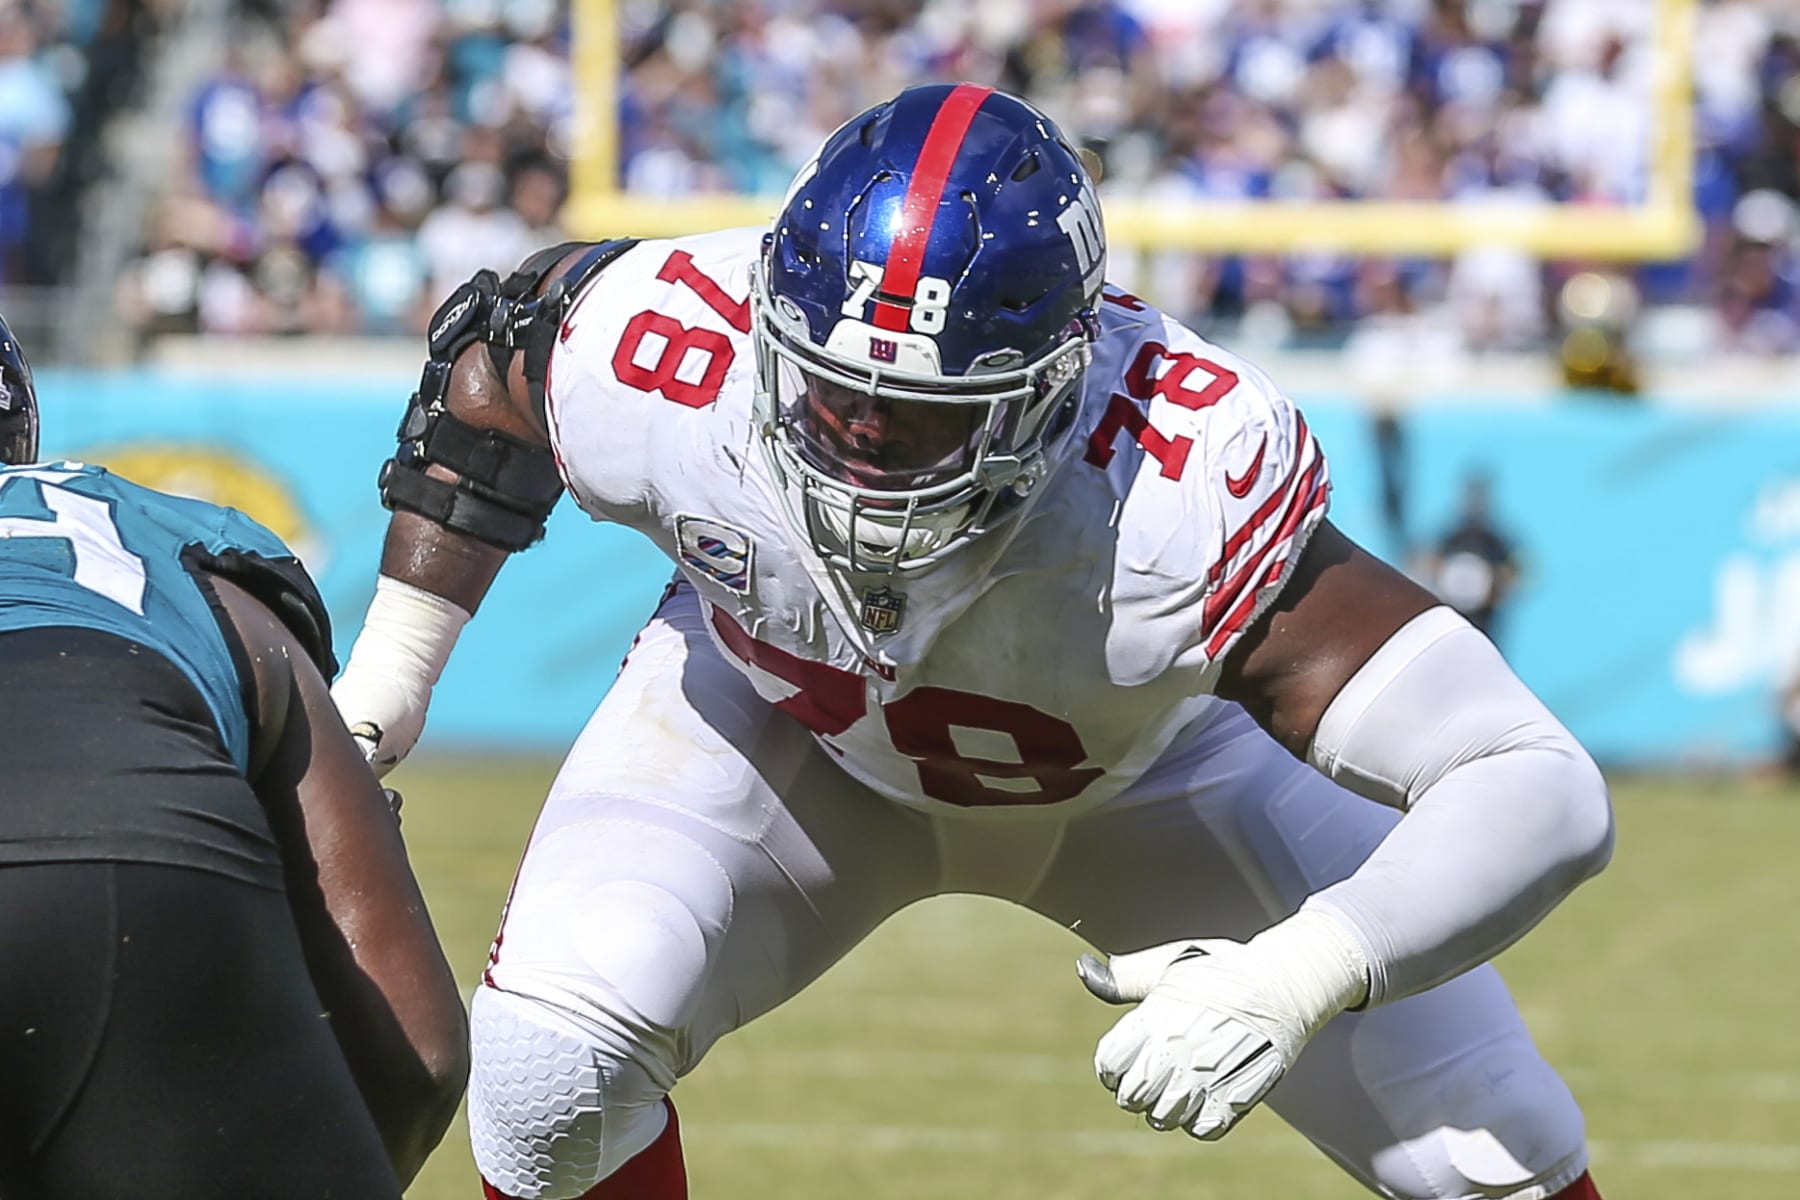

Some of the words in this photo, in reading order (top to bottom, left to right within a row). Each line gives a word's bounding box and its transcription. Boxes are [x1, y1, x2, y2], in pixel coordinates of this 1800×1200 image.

[611, 249, 752, 409] 78
[1083, 341, 1239, 482] 78
[865, 606, 896, 628] NFL
[711, 602, 1106, 808] 78
